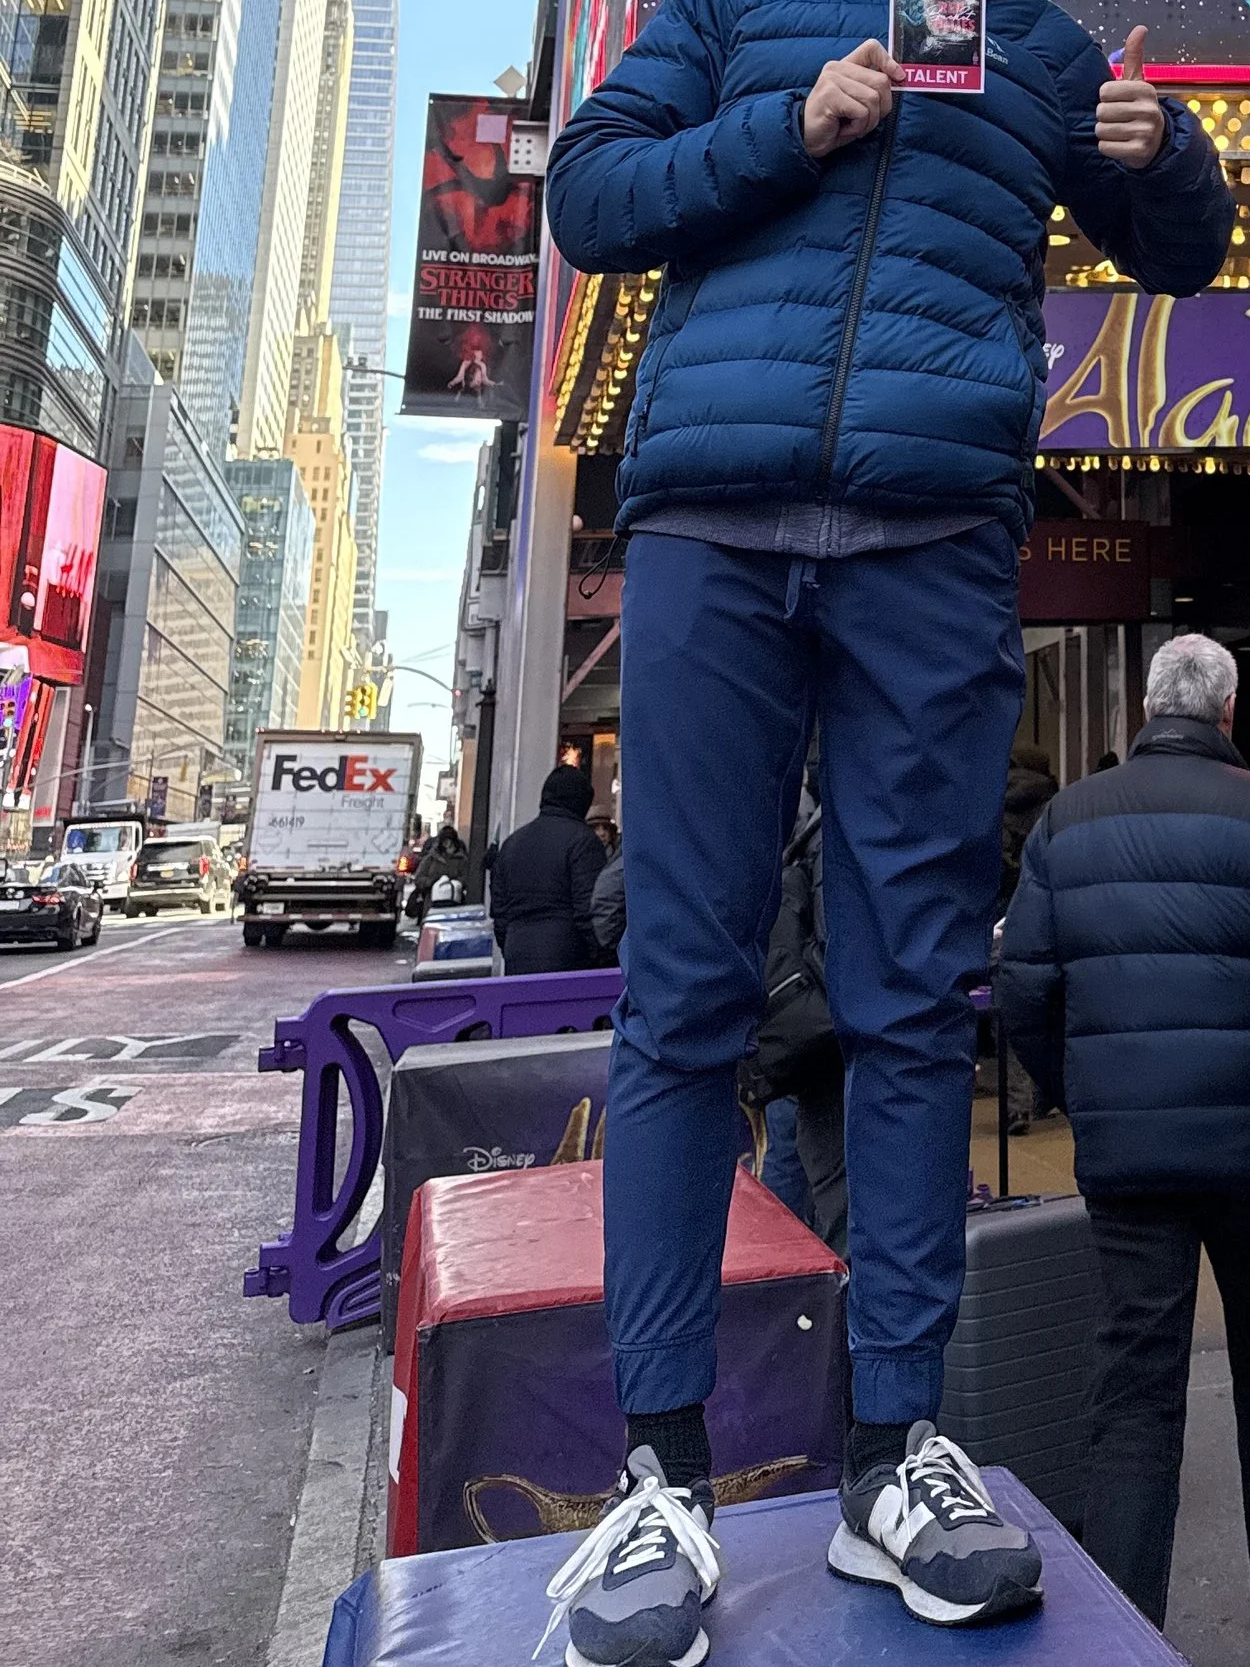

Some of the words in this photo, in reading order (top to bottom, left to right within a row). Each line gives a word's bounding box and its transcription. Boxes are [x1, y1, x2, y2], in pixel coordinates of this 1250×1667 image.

[904, 68, 969, 85] TALENT
[422, 249, 448, 262] LIVE
[449, 251, 470, 263] ON
[471, 253, 537, 266] BROADWAY
[420, 265, 535, 297] STRANGER
[437, 289, 519, 311] THINGS
[418, 306, 443, 321] THE
[445, 308, 483, 323] FIRST
[483, 310, 535, 324] SHADOW
[1047, 537, 1132, 563] HERE
[270, 754, 398, 794] FedEx
[340, 795, 386, 809] Freight
